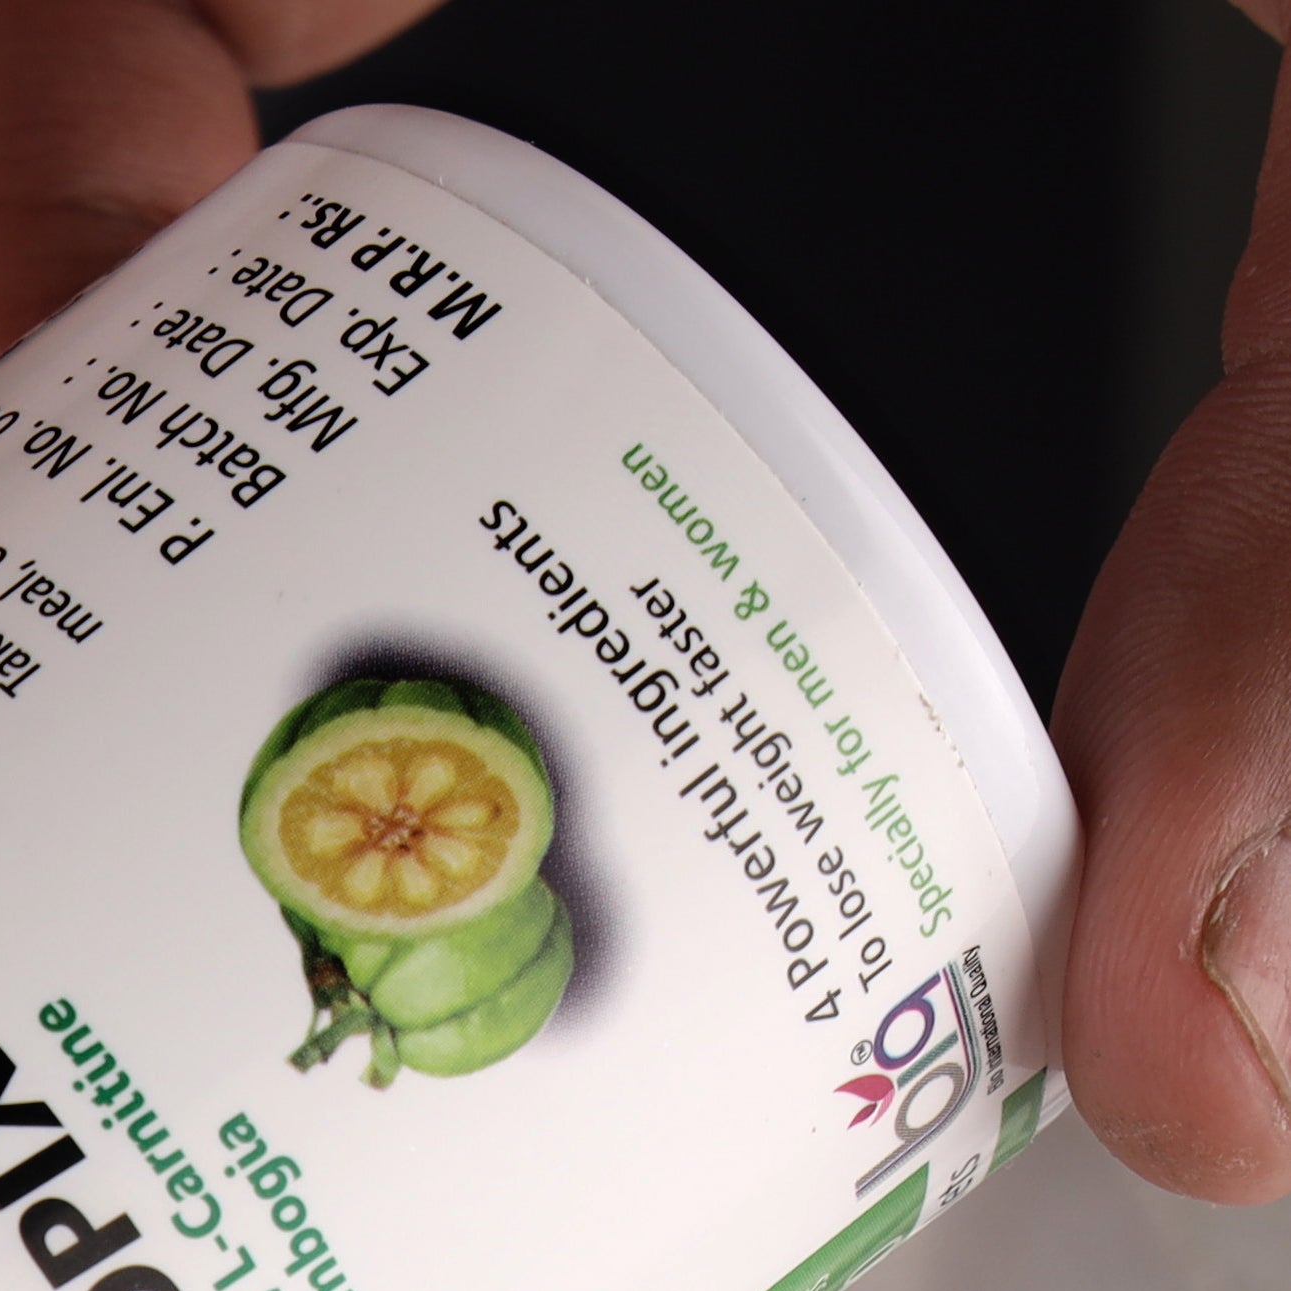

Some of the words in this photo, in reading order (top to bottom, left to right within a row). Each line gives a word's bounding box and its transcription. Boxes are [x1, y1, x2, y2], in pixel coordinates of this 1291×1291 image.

[232, 255, 334, 328] Date
[351, 226, 503, 341] M.R.P.
[154, 308, 255, 379] Date
[340, 307, 430, 397] Exp.
[98, 365, 167, 426] No.
[258, 356, 359, 454] Mfg.
[23, 419, 93, 480] No.
[156, 403, 287, 510] Batch
[159, 516, 216, 566] P.
[622, 441, 742, 583] women
[478, 498, 701, 770] ingredients
[629, 576, 732, 699] faster
[733, 580, 771, 621] &
[765, 620, 835, 711] men
[719, 691, 825, 845] weight
[824, 713, 873, 778] for
[678, 761, 831, 991] Powerful
[818, 847, 885, 925] lose
[861, 773, 954, 940] Specially
[804, 987, 842, 1024] 4
[858, 936, 894, 993] To
[961, 944, 988, 998] Quality
[973, 992, 1005, 1074] International
